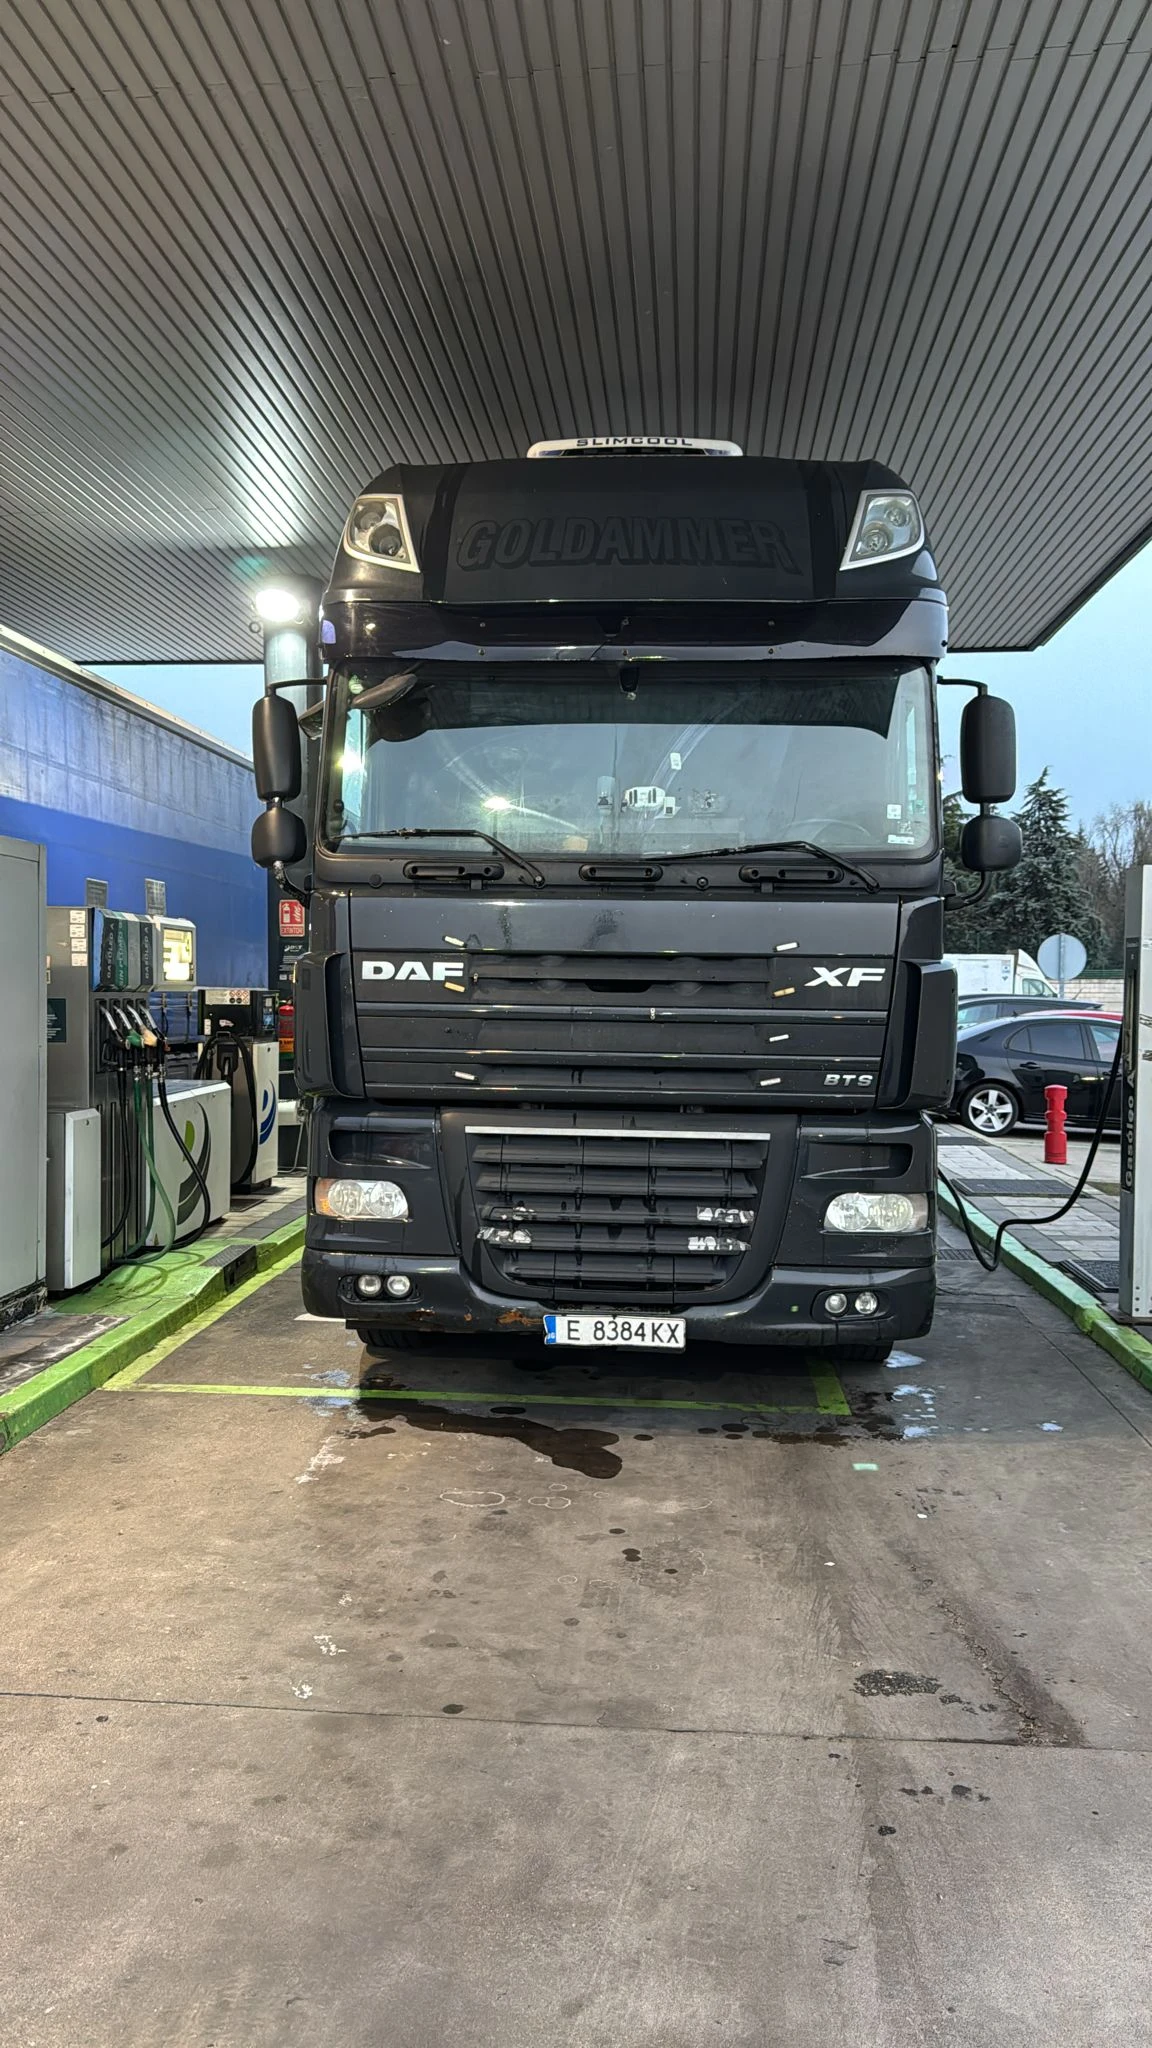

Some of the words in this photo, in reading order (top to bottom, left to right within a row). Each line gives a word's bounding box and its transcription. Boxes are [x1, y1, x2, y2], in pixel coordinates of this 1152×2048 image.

[576, 437, 693, 447] SLIMCOOL
[456, 515, 803, 575] GOLDAMMER
[362, 961, 464, 981] DAF
[804, 967, 886, 987] XF
[823, 1074, 873, 1087] BTS
[1126, 1069, 1137, 1088] A
[567, 1320, 580, 1341] E
